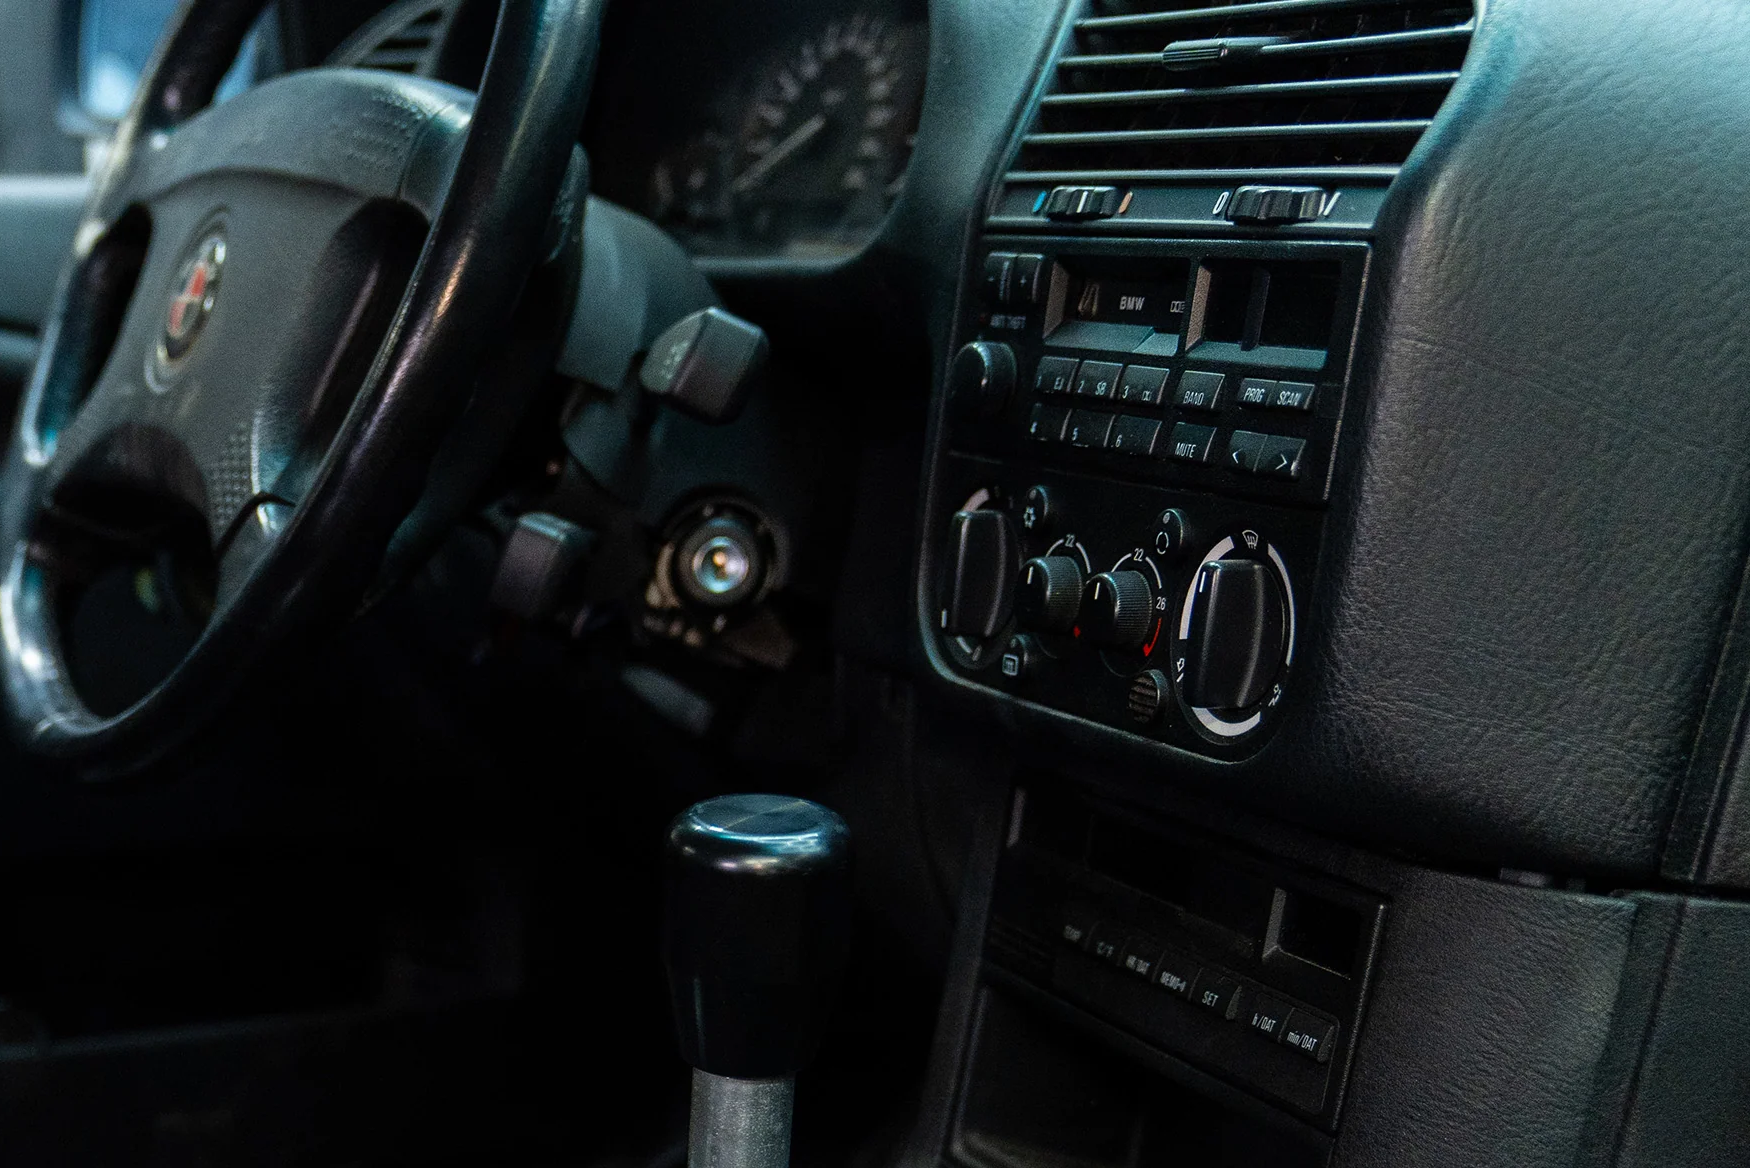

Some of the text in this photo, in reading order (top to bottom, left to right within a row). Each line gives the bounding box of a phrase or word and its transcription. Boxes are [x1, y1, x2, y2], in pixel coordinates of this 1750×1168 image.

[1119, 295, 1146, 311] BMW
[1121, 385, 1130, 399] 3
[1182, 390, 1205, 407] BAND
[1243, 387, 1266, 403] PROG
[1276, 390, 1302, 407] SCAN
[1071, 427, 1079, 441] 5
[1115, 434, 1123, 448] 6
[1174, 442, 1197, 459] MUTE
[1063, 533, 1076, 548] 22
[1133, 547, 1144, 563] 22
[1155, 596, 1167, 612] 26
[1201, 990, 1219, 1007] SET
